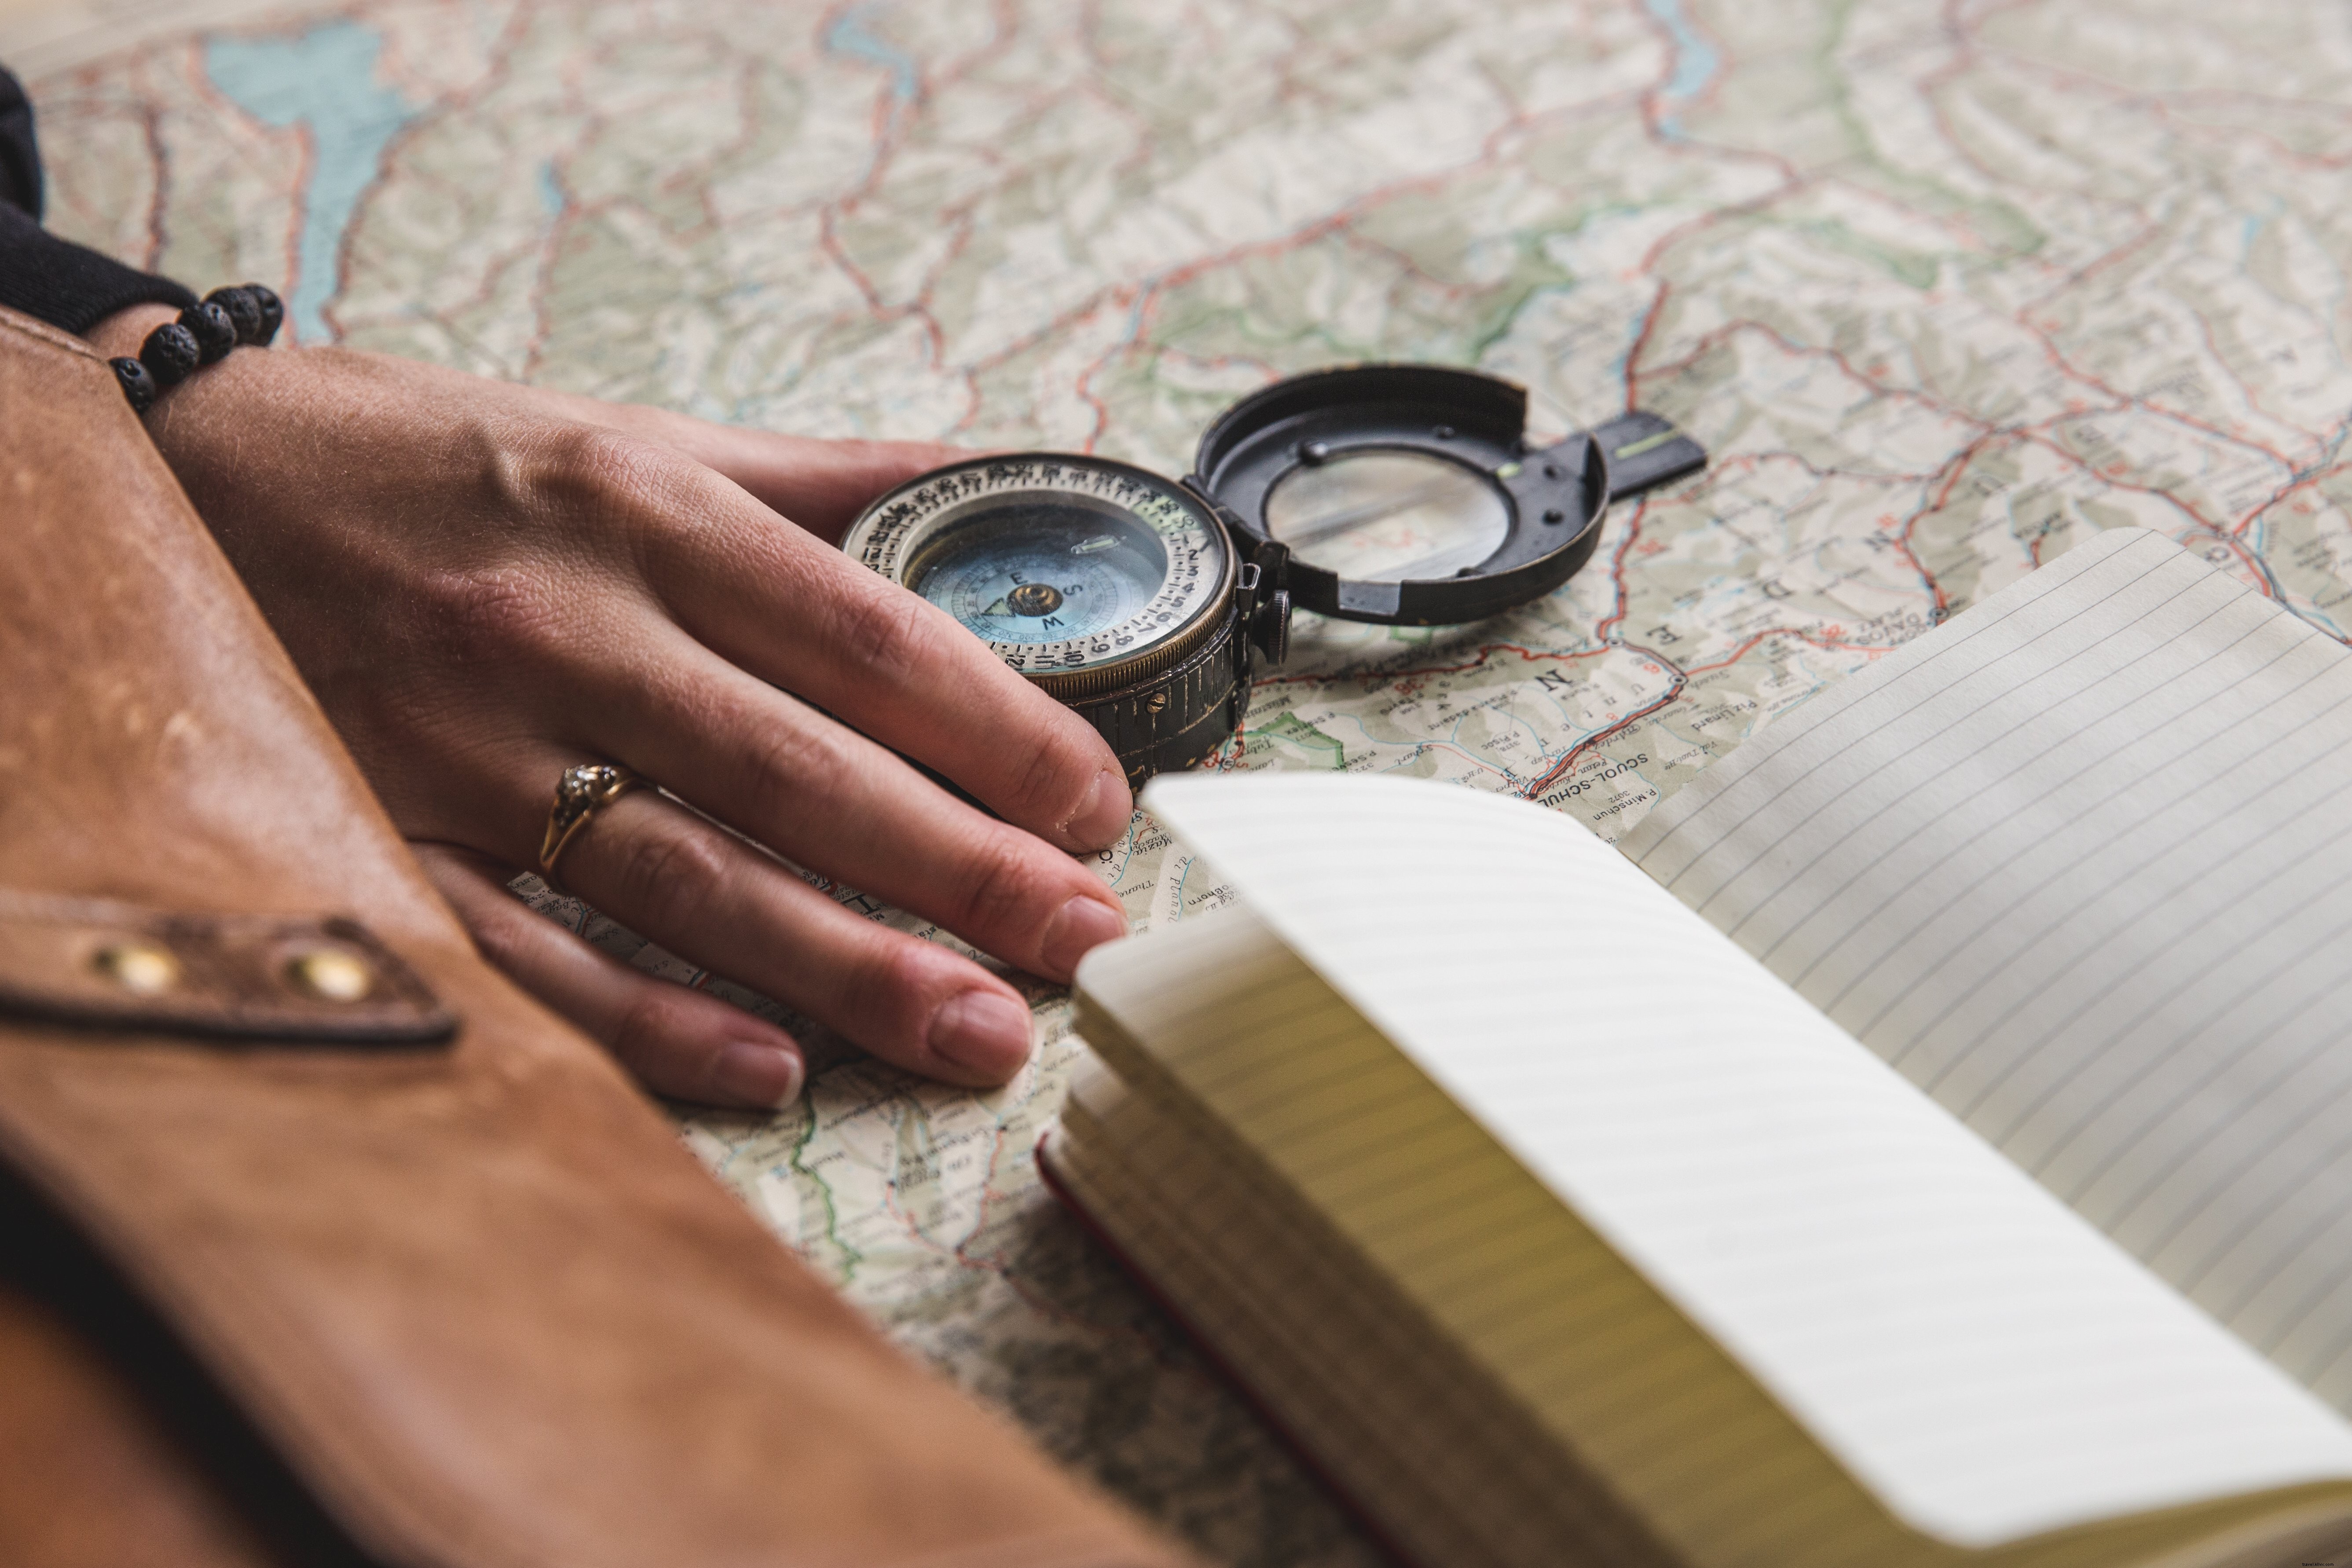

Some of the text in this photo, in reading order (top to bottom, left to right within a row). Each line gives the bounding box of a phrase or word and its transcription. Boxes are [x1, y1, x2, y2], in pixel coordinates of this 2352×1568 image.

[1188, 549, 1199, 561] 2
[1187, 565, 1199, 576] 3
[1010, 572, 1028, 585] E
[1062, 584, 1083, 596] S
[1182, 582, 1195, 593] 4
[1170, 596, 1187, 608] 5
[1155, 612, 1173, 623] 6
[1137, 623, 1158, 633] 7
[1115, 635, 1135, 646] 8
[1091, 643, 1111, 653] 9
[1535, 668, 1573, 693] N
[1690, 708, 1736, 733] Linard
[1480, 733, 1509, 751] Pisoc
[1537, 753, 1649, 808] SCUOL-SCHUL
[1607, 790, 1630, 803] 3072
[1593, 788, 1657, 821] P. Minschun
[1098, 849, 1114, 864] Ö
[1114, 880, 1154, 898] Thane
